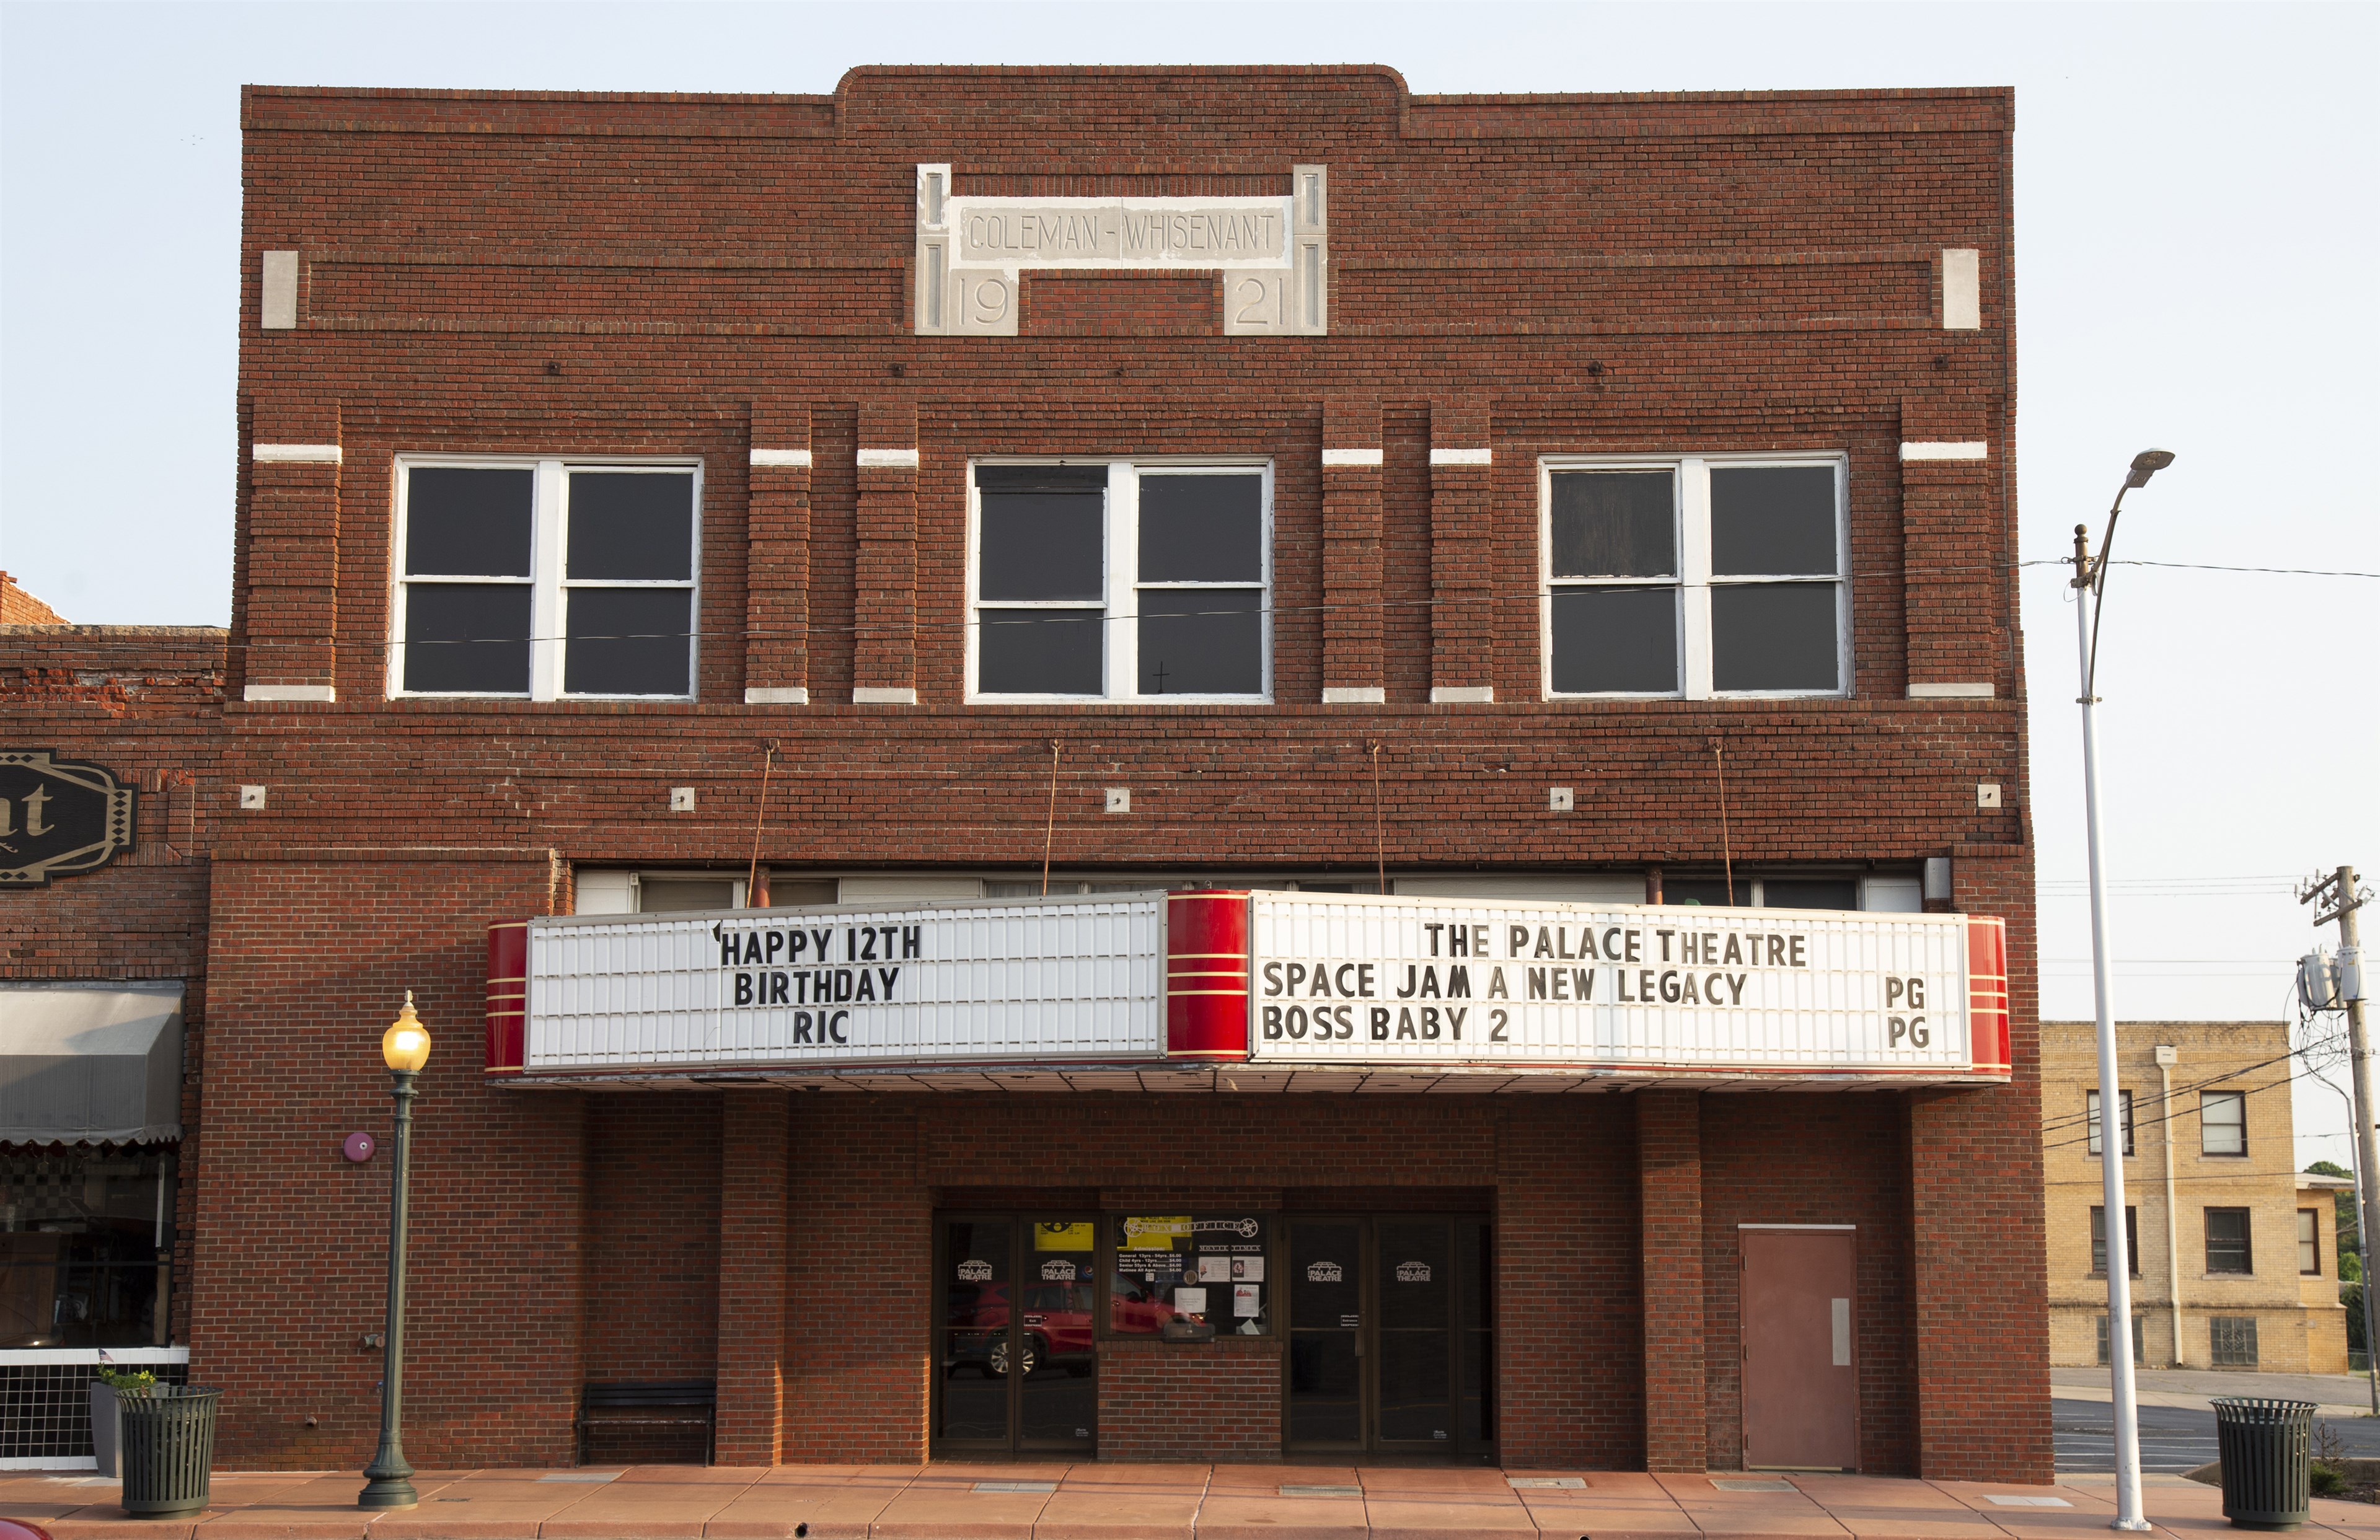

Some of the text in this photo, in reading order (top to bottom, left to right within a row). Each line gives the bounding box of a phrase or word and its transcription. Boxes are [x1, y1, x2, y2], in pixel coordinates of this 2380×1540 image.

[968, 214, 1098, 250] COLEMAN
[1124, 214, 1275, 250] WHISENANT
[958, 277, 1284, 326] 19 21
[721, 925, 920, 966] HAPPY 12TH
[1424, 923, 1806, 967] THE PALACE THEATRE
[734, 967, 899, 1006] BIRTHDAY
[1263, 961, 1924, 1010] SPACE JAM A NEW LEGACY PG
[793, 1010, 848, 1044] RIC
[1263, 1006, 1929, 1049] BOSS BABY 2 PG
[1183, 1221, 1240, 1231] OFFICE
